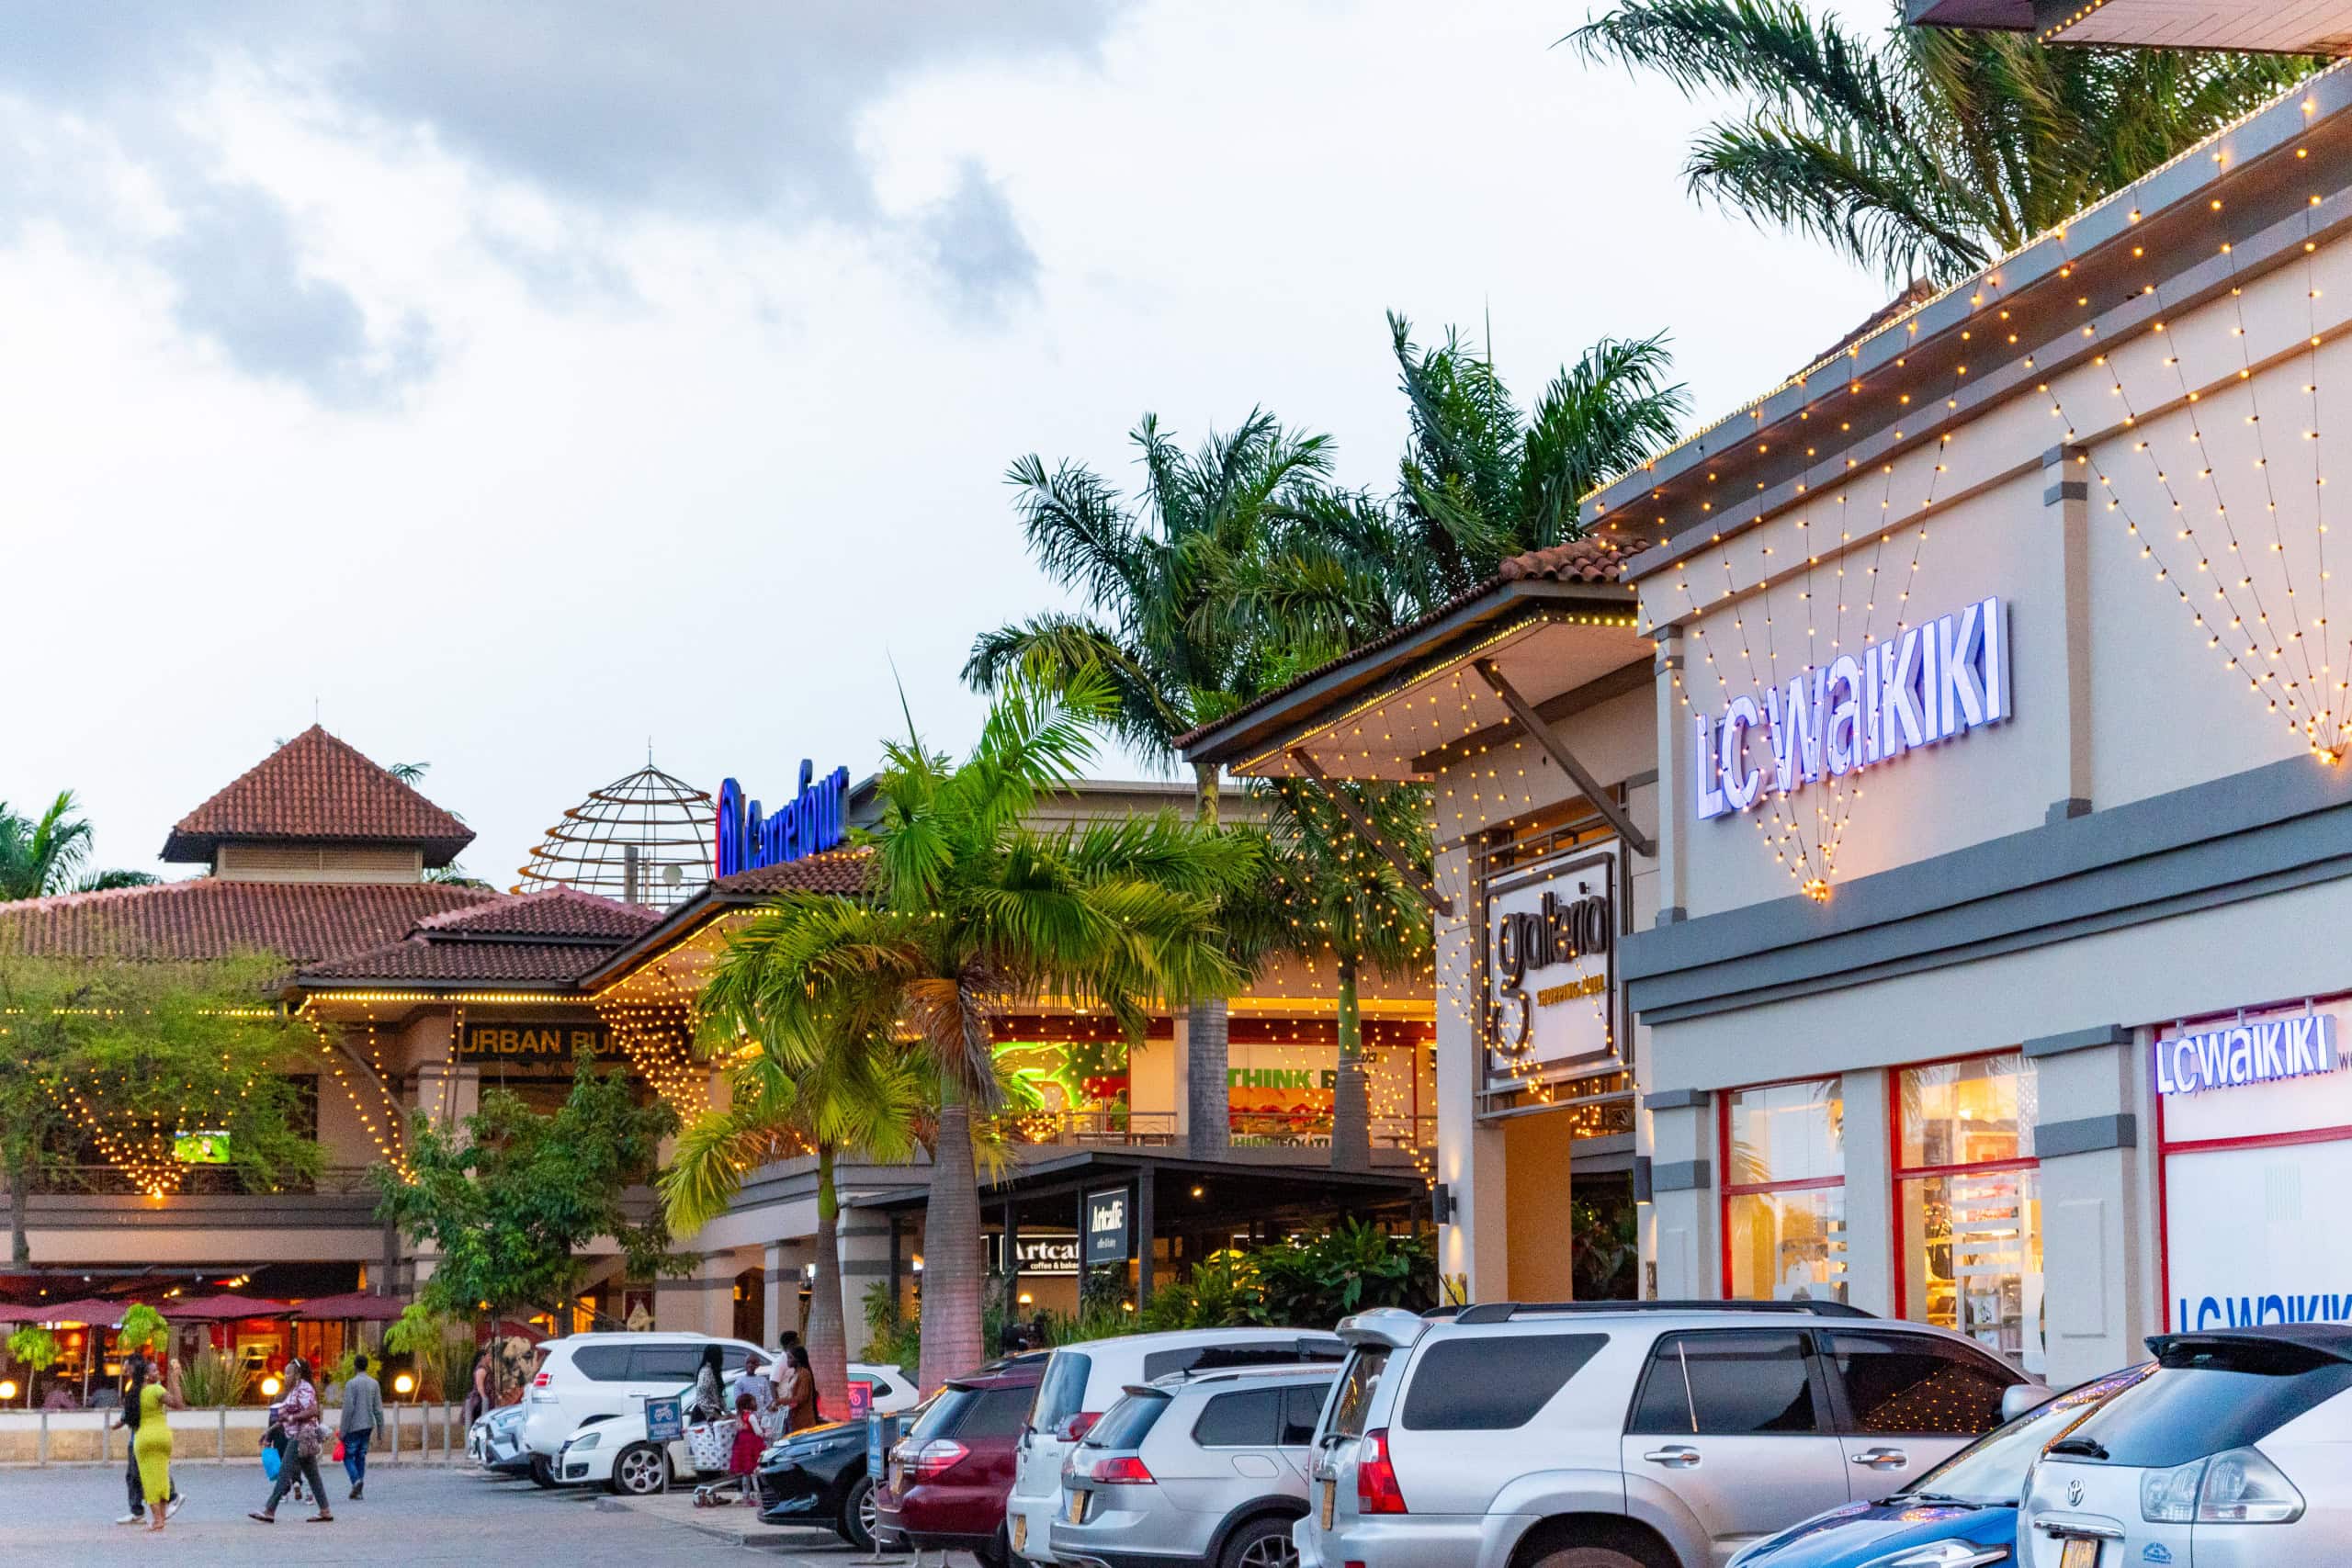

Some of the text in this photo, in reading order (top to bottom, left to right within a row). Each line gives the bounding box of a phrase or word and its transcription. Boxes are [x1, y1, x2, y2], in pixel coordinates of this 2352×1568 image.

[1696, 695, 1760, 820] LC
[1536, 981, 1582, 1008] SHOPPING
[461, 1029, 560, 1055] URBAN
[1227, 1067, 1315, 1089] THINK
[2155, 1037, 2199, 1094] LC
[1232, 1135, 1275, 1147] HINK
